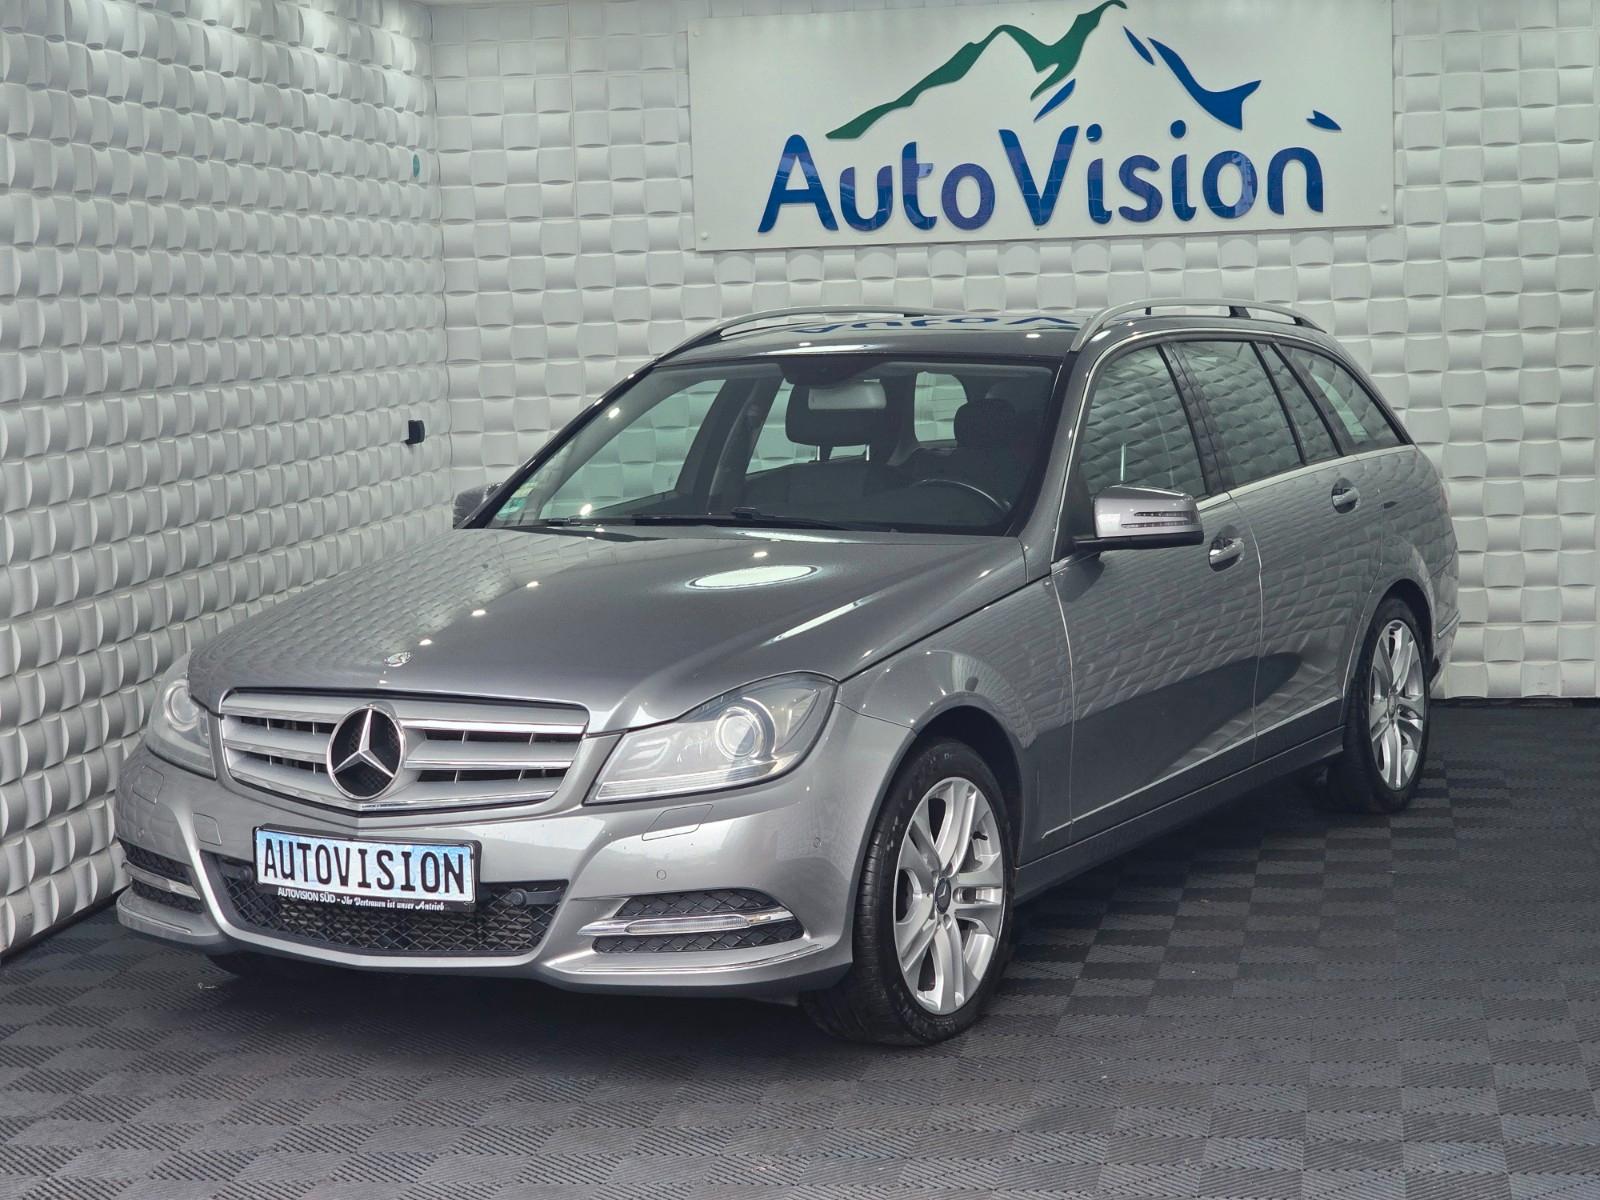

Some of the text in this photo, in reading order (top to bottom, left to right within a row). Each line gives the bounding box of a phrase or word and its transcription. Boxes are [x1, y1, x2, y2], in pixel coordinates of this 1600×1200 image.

[757, 119, 1323, 233] AutoVision
[264, 838, 465, 894] AUTOVISION
[277, 886, 319, 902] AUTOVISION
[320, 891, 336, 904] SÜD
[387, 899, 396, 908] ist
[396, 901, 415, 909] unser
[415, 900, 445, 911] Antrieb
